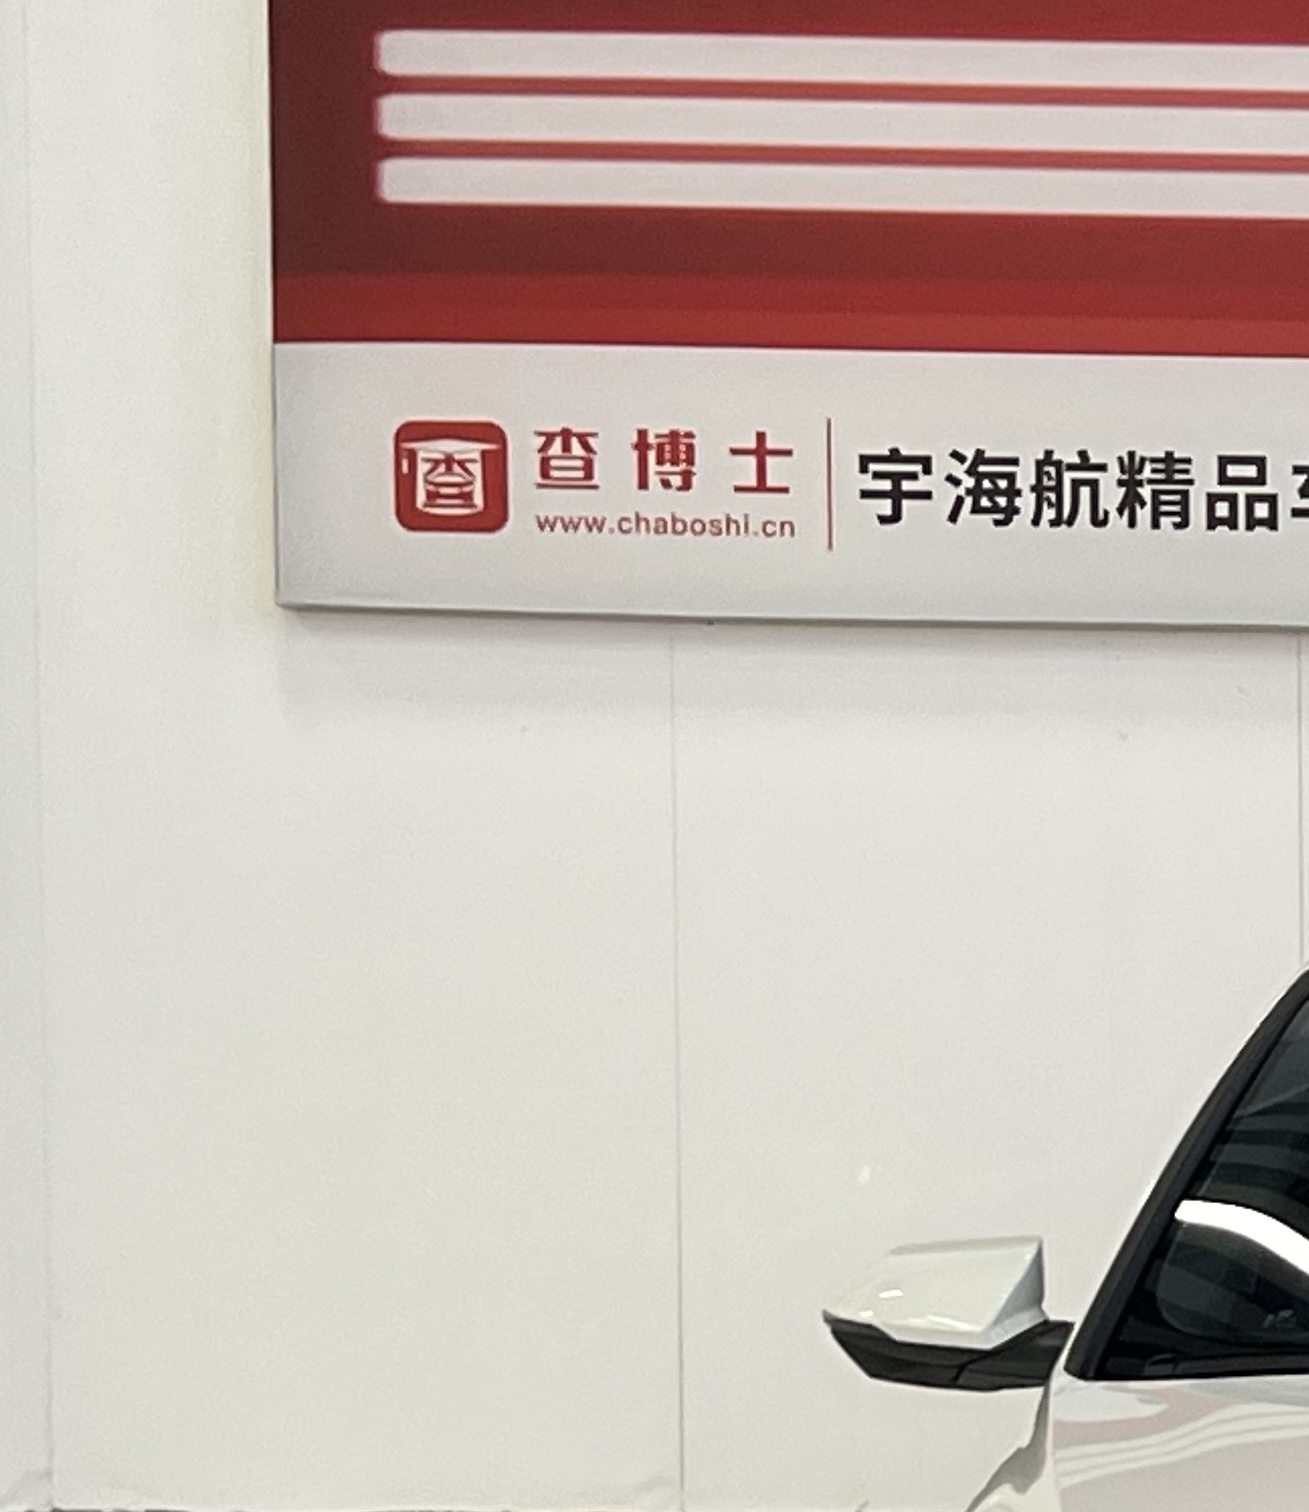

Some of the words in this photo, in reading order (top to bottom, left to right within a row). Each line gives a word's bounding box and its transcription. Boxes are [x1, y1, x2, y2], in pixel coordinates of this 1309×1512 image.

[534, 427, 794, 494] 查博士
[536, 511, 796, 538] www.chaboshi.cn
